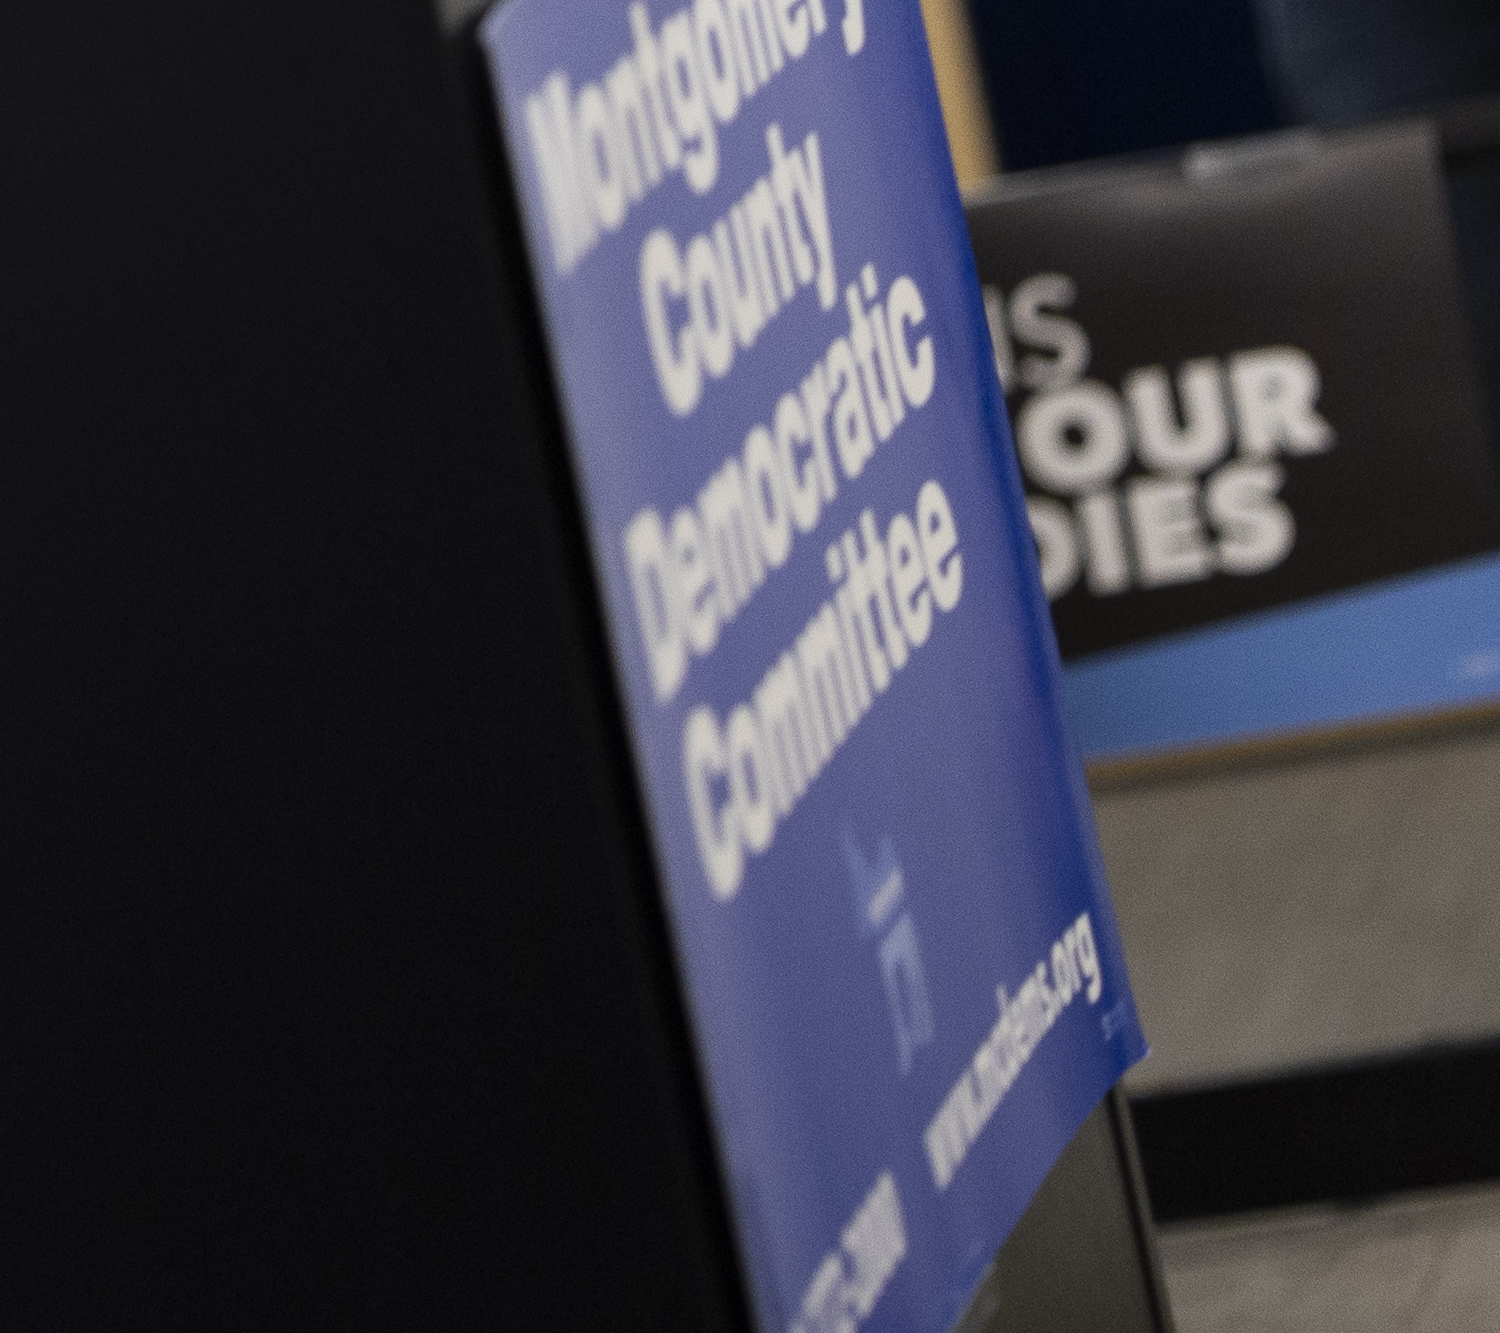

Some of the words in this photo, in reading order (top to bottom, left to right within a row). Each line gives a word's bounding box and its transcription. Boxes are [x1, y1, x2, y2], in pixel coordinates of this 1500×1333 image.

[639, 122, 838, 417] County
[623, 263, 936, 704] Democratic
[683, 479, 964, 902] Committee
